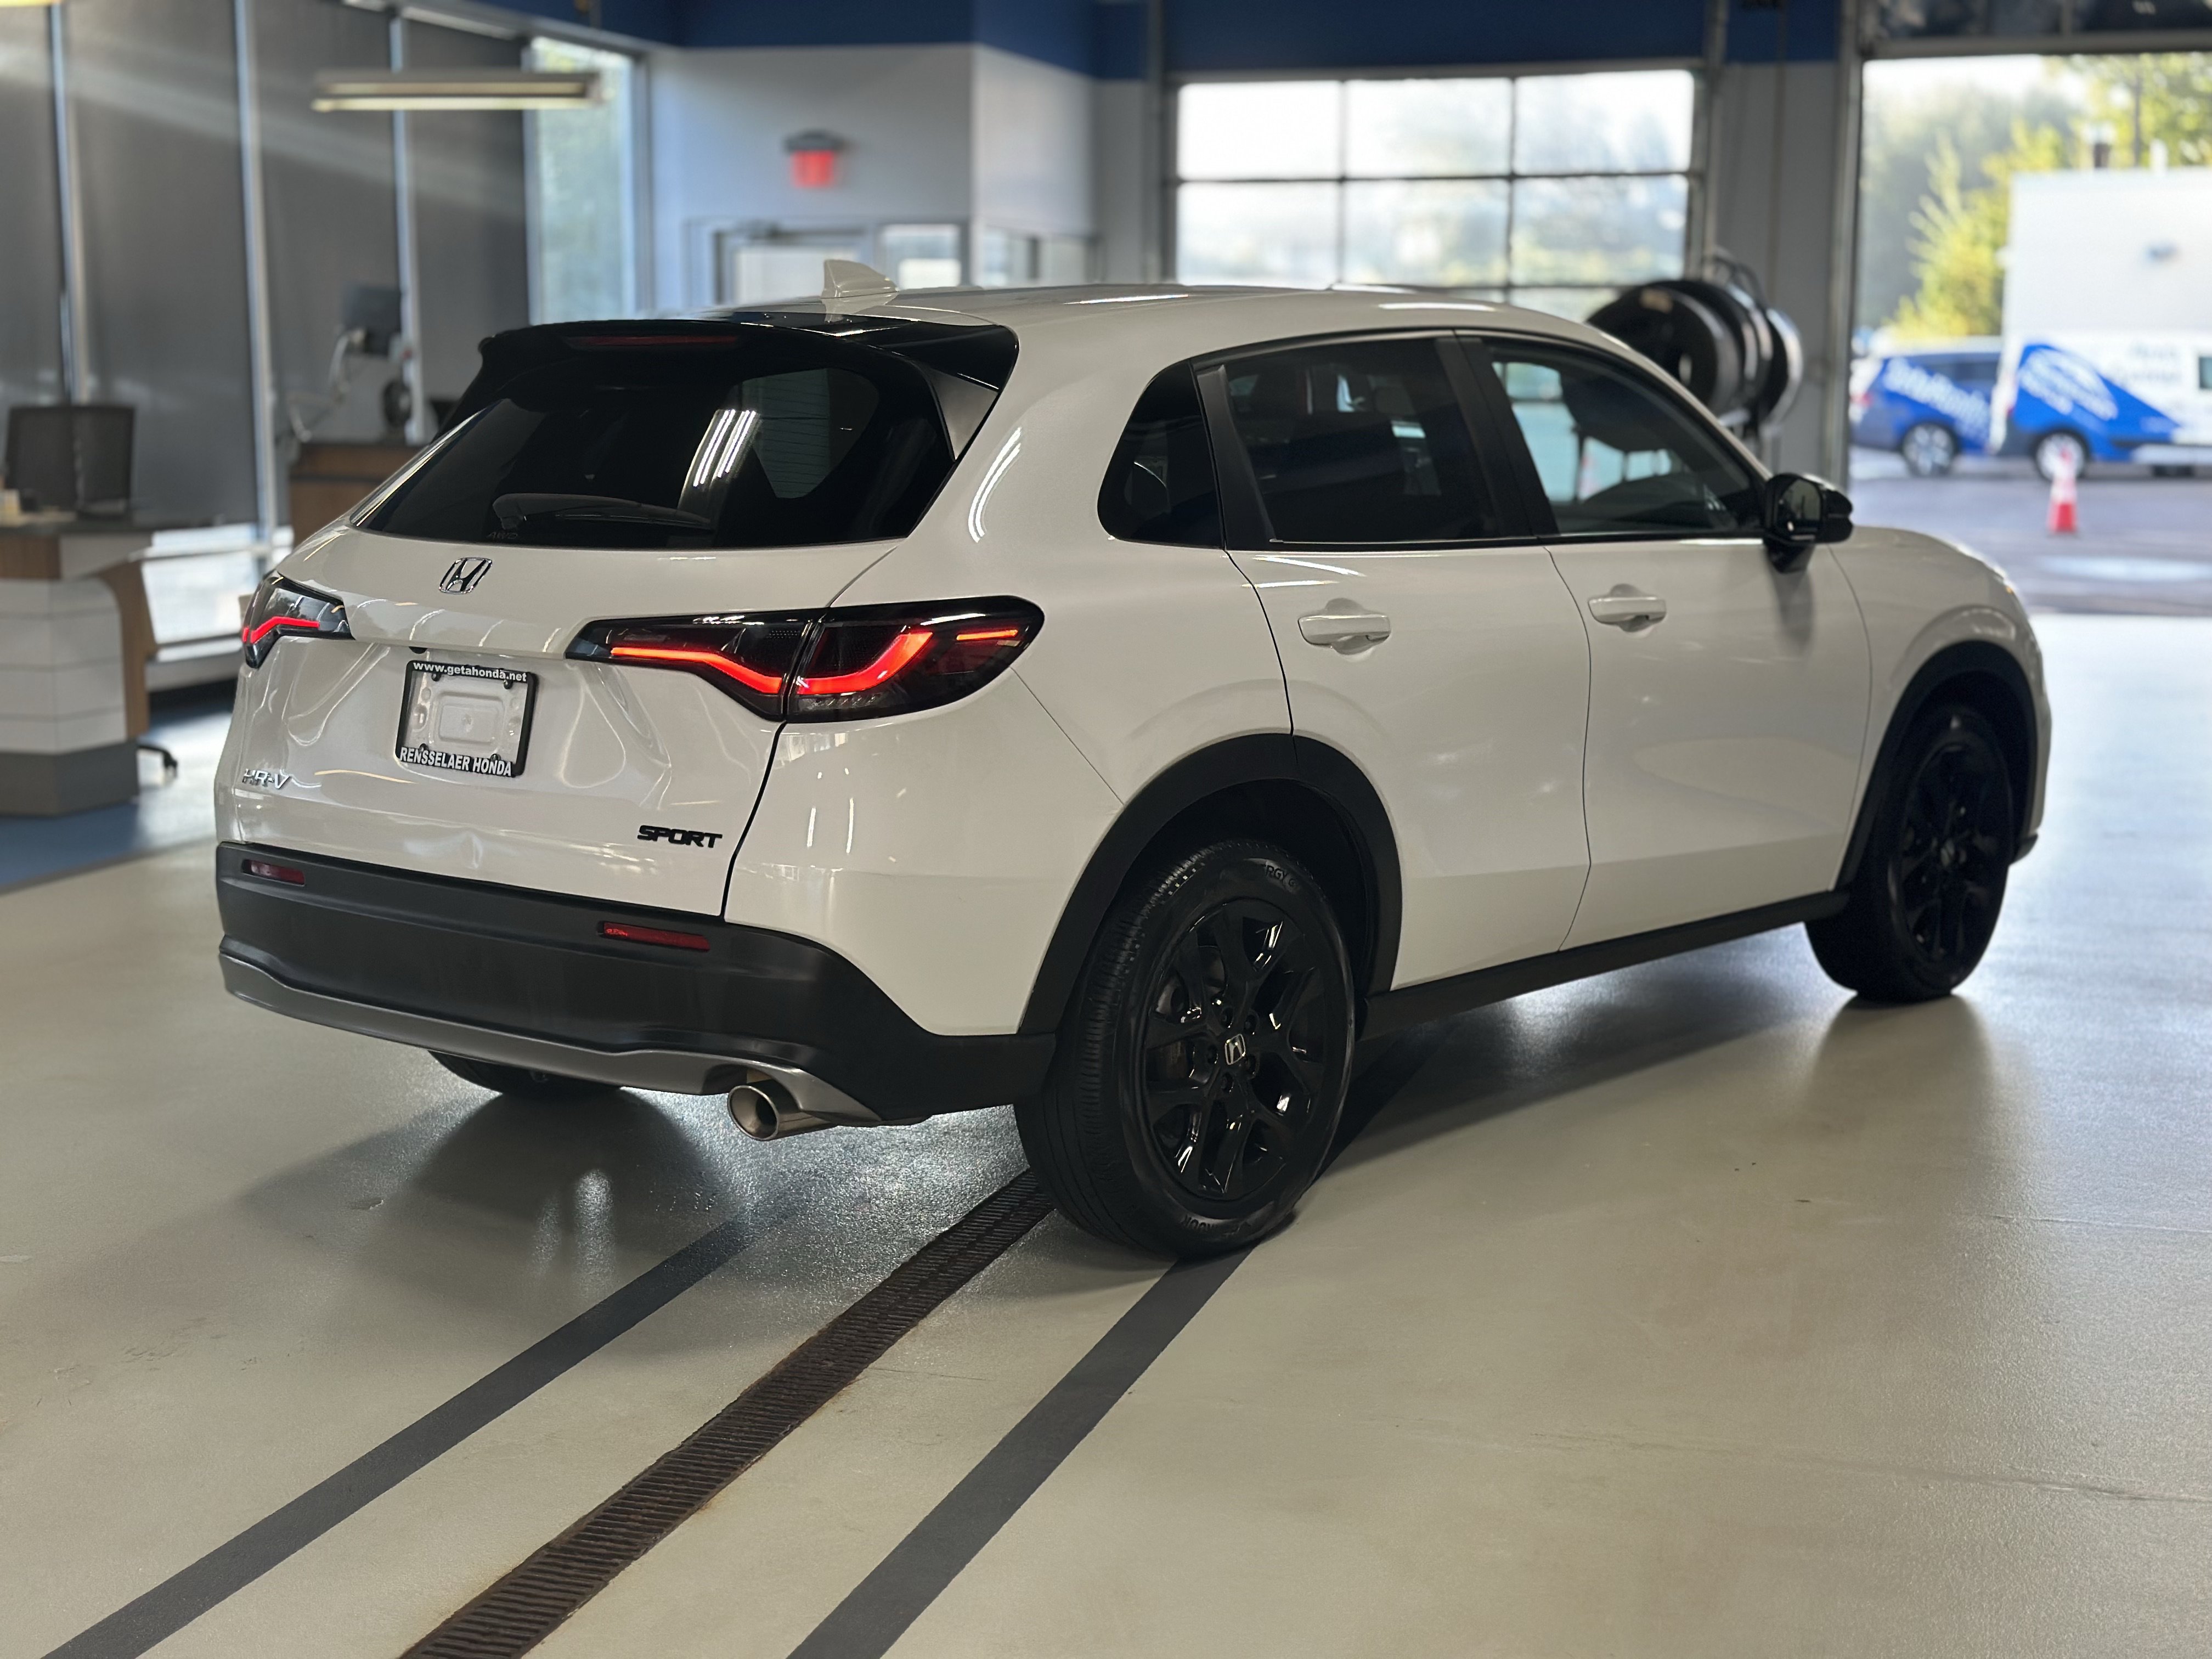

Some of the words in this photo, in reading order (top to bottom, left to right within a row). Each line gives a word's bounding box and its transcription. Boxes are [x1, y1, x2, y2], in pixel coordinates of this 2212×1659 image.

[413, 662, 527, 681] www.getahonda.net
[400, 747, 470, 770] RENSSELAER
[473, 758, 511, 776] HONDA
[242, 769, 289, 789] HR-V
[637, 825, 723, 848] SPORT
